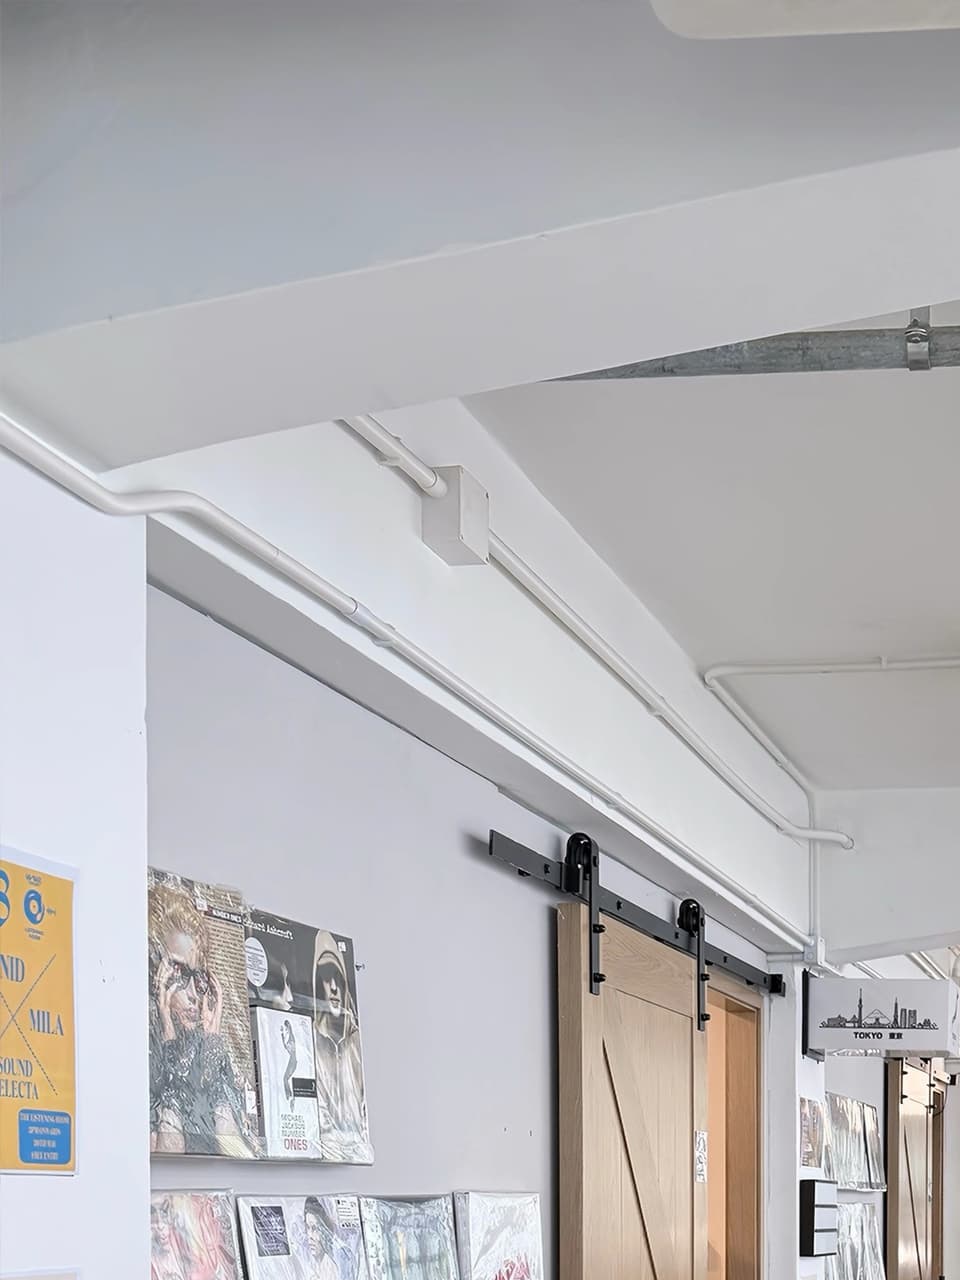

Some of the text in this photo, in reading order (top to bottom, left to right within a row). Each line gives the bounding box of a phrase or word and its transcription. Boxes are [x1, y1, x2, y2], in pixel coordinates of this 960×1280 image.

[30, 1008, 64, 1036] MILA
[853, 1031, 883, 1039] TOKYO
[284, 1138, 308, 1151] ONES
